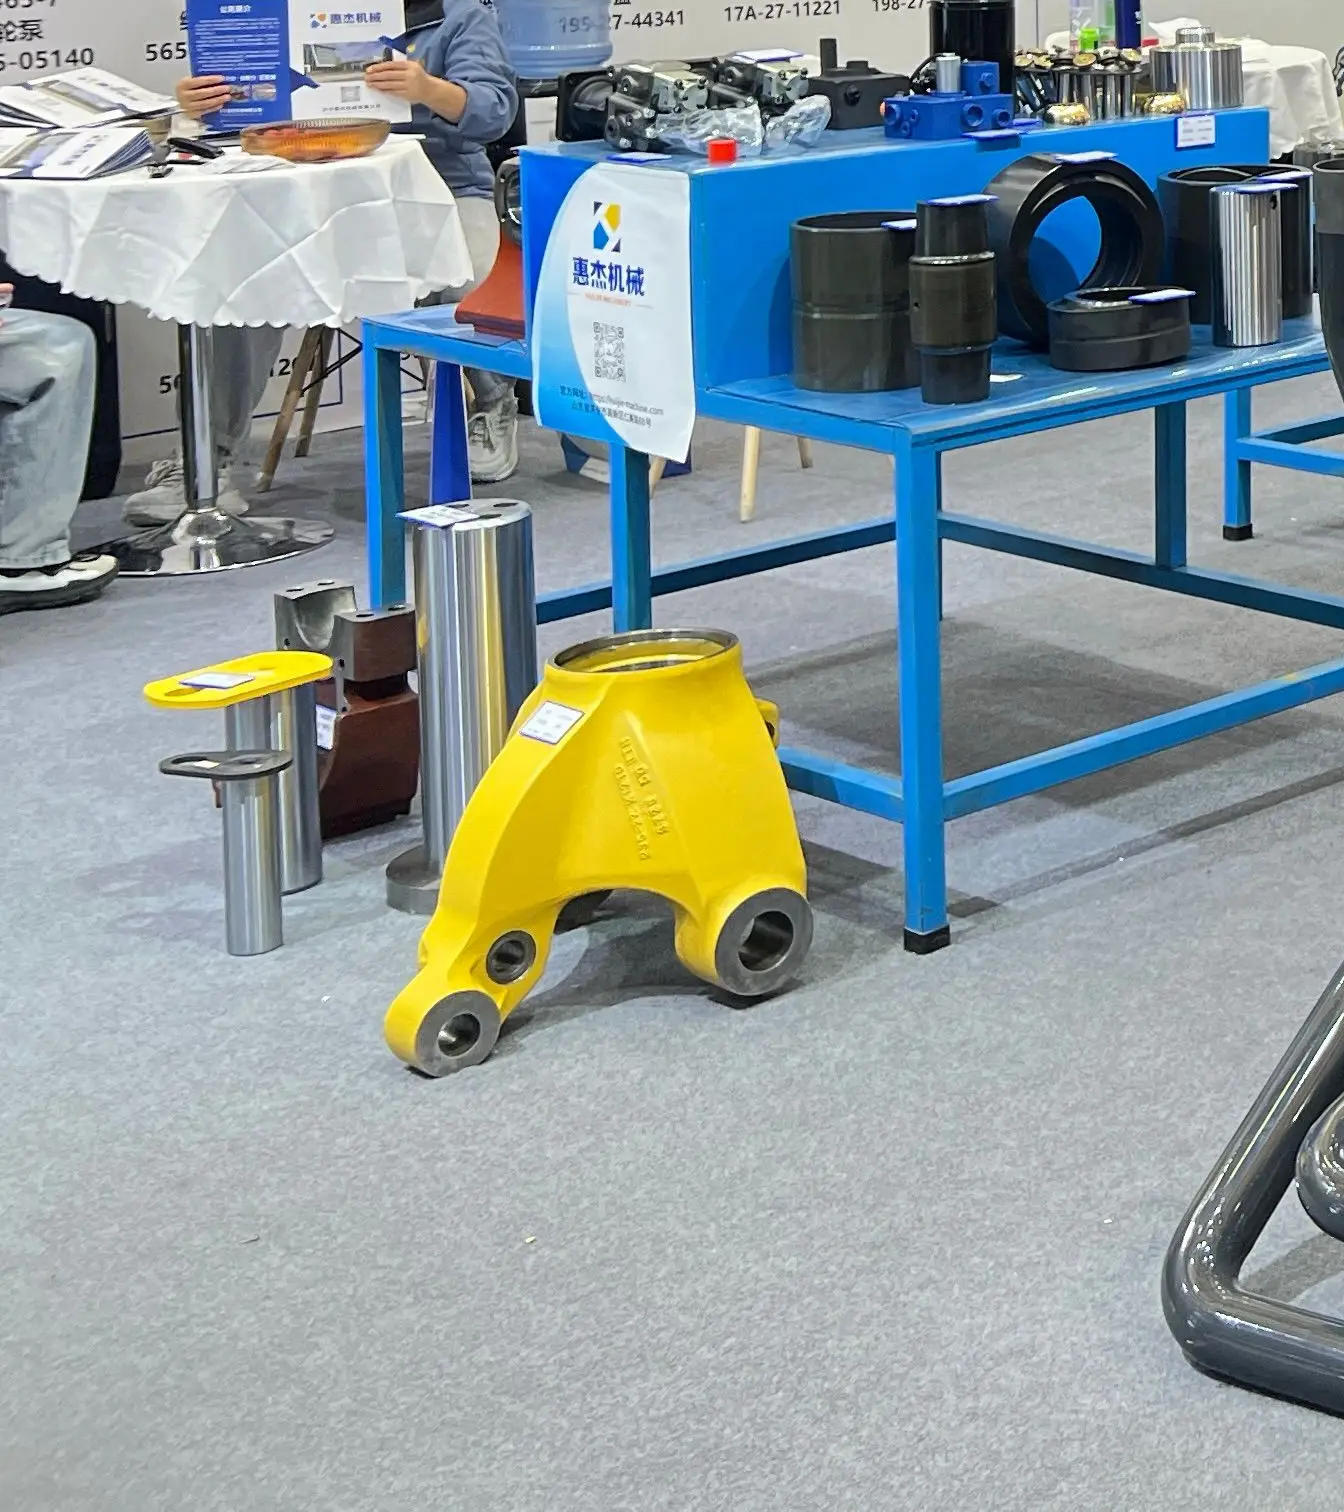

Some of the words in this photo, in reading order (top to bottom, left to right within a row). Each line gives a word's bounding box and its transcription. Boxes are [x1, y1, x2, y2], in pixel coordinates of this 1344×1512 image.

[723, 0, 843, 23] 17A-27-11221
[571, 256, 646, 297] 惠杰机械
